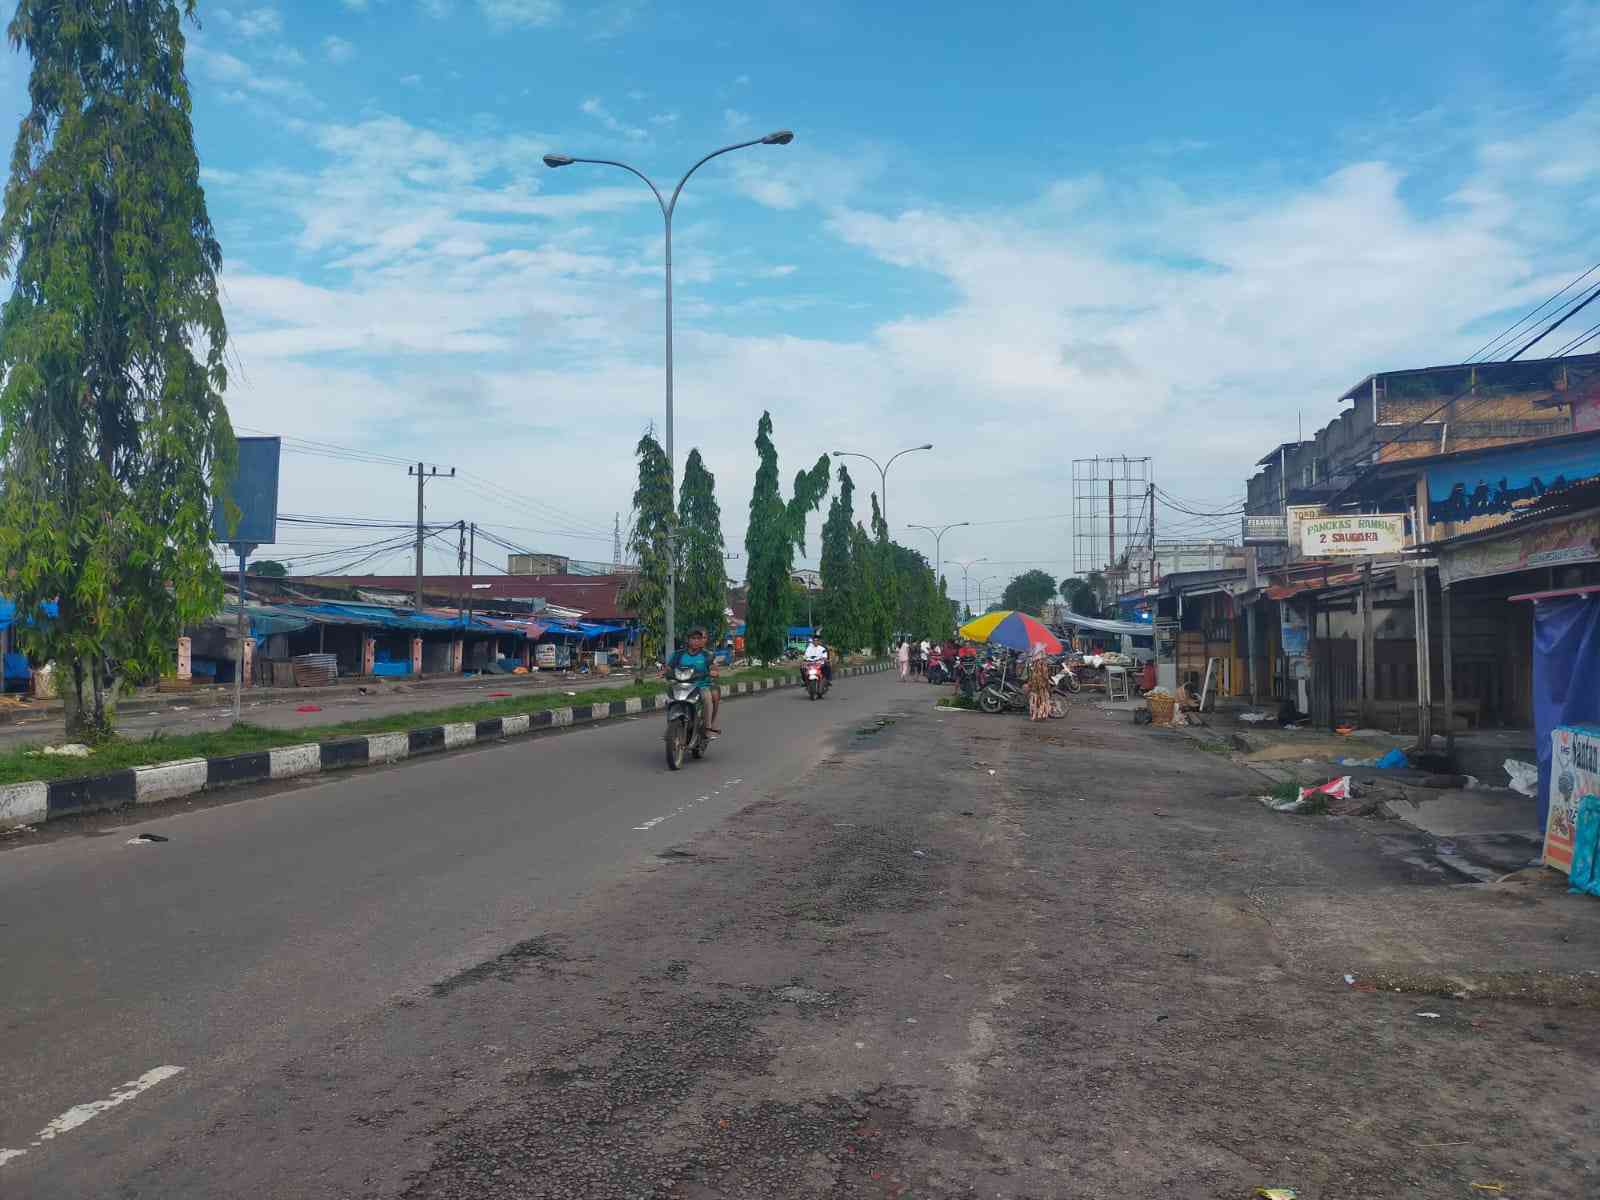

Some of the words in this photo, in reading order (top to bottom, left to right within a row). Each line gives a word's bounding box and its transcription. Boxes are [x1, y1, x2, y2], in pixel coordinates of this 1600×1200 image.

[1307, 520, 1351, 535] PANGKAS
[1358, 520, 1397, 534] RAMBUT
[1320, 534, 1327, 543] 2
[1332, 532, 1377, 543] SAUDARA
